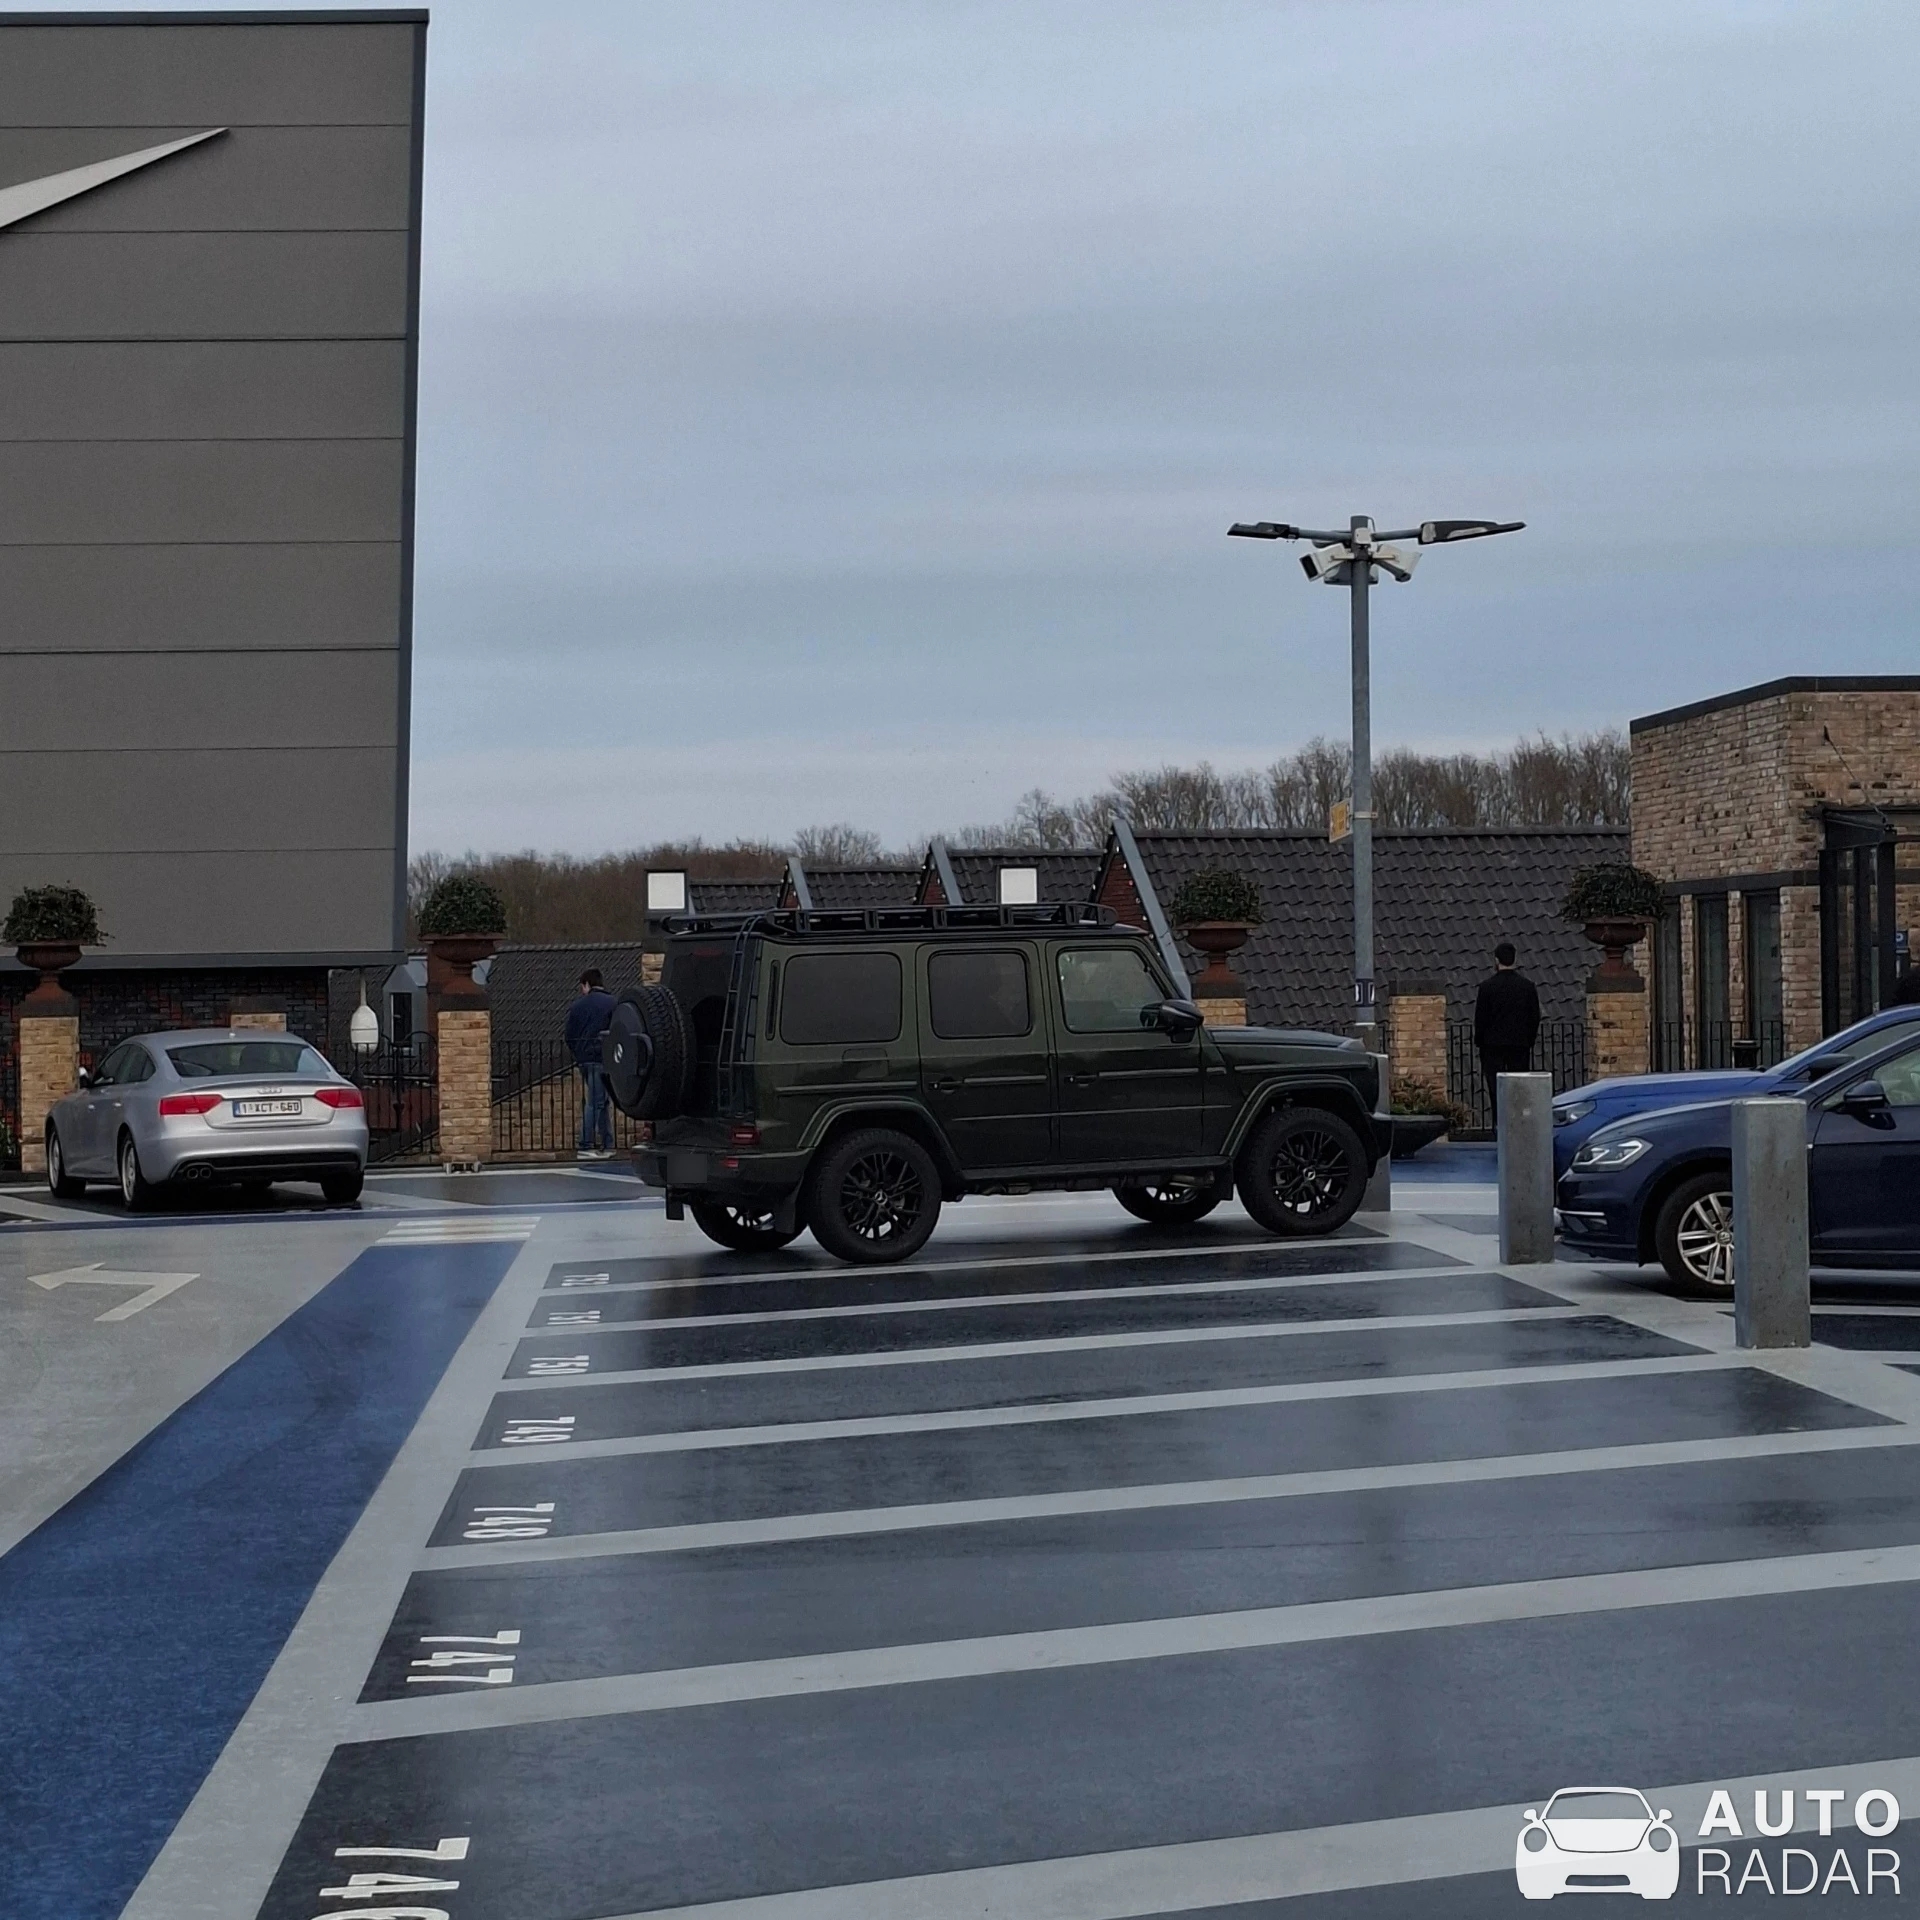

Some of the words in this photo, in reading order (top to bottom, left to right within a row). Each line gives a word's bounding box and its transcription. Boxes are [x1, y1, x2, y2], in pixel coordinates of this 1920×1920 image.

[547, 1310, 601, 1325] 751
[527, 1355, 590, 1375] 750
[501, 1416, 576, 1443] 749
[463, 1503, 556, 1538] 748
[406, 1630, 521, 1683] 747
